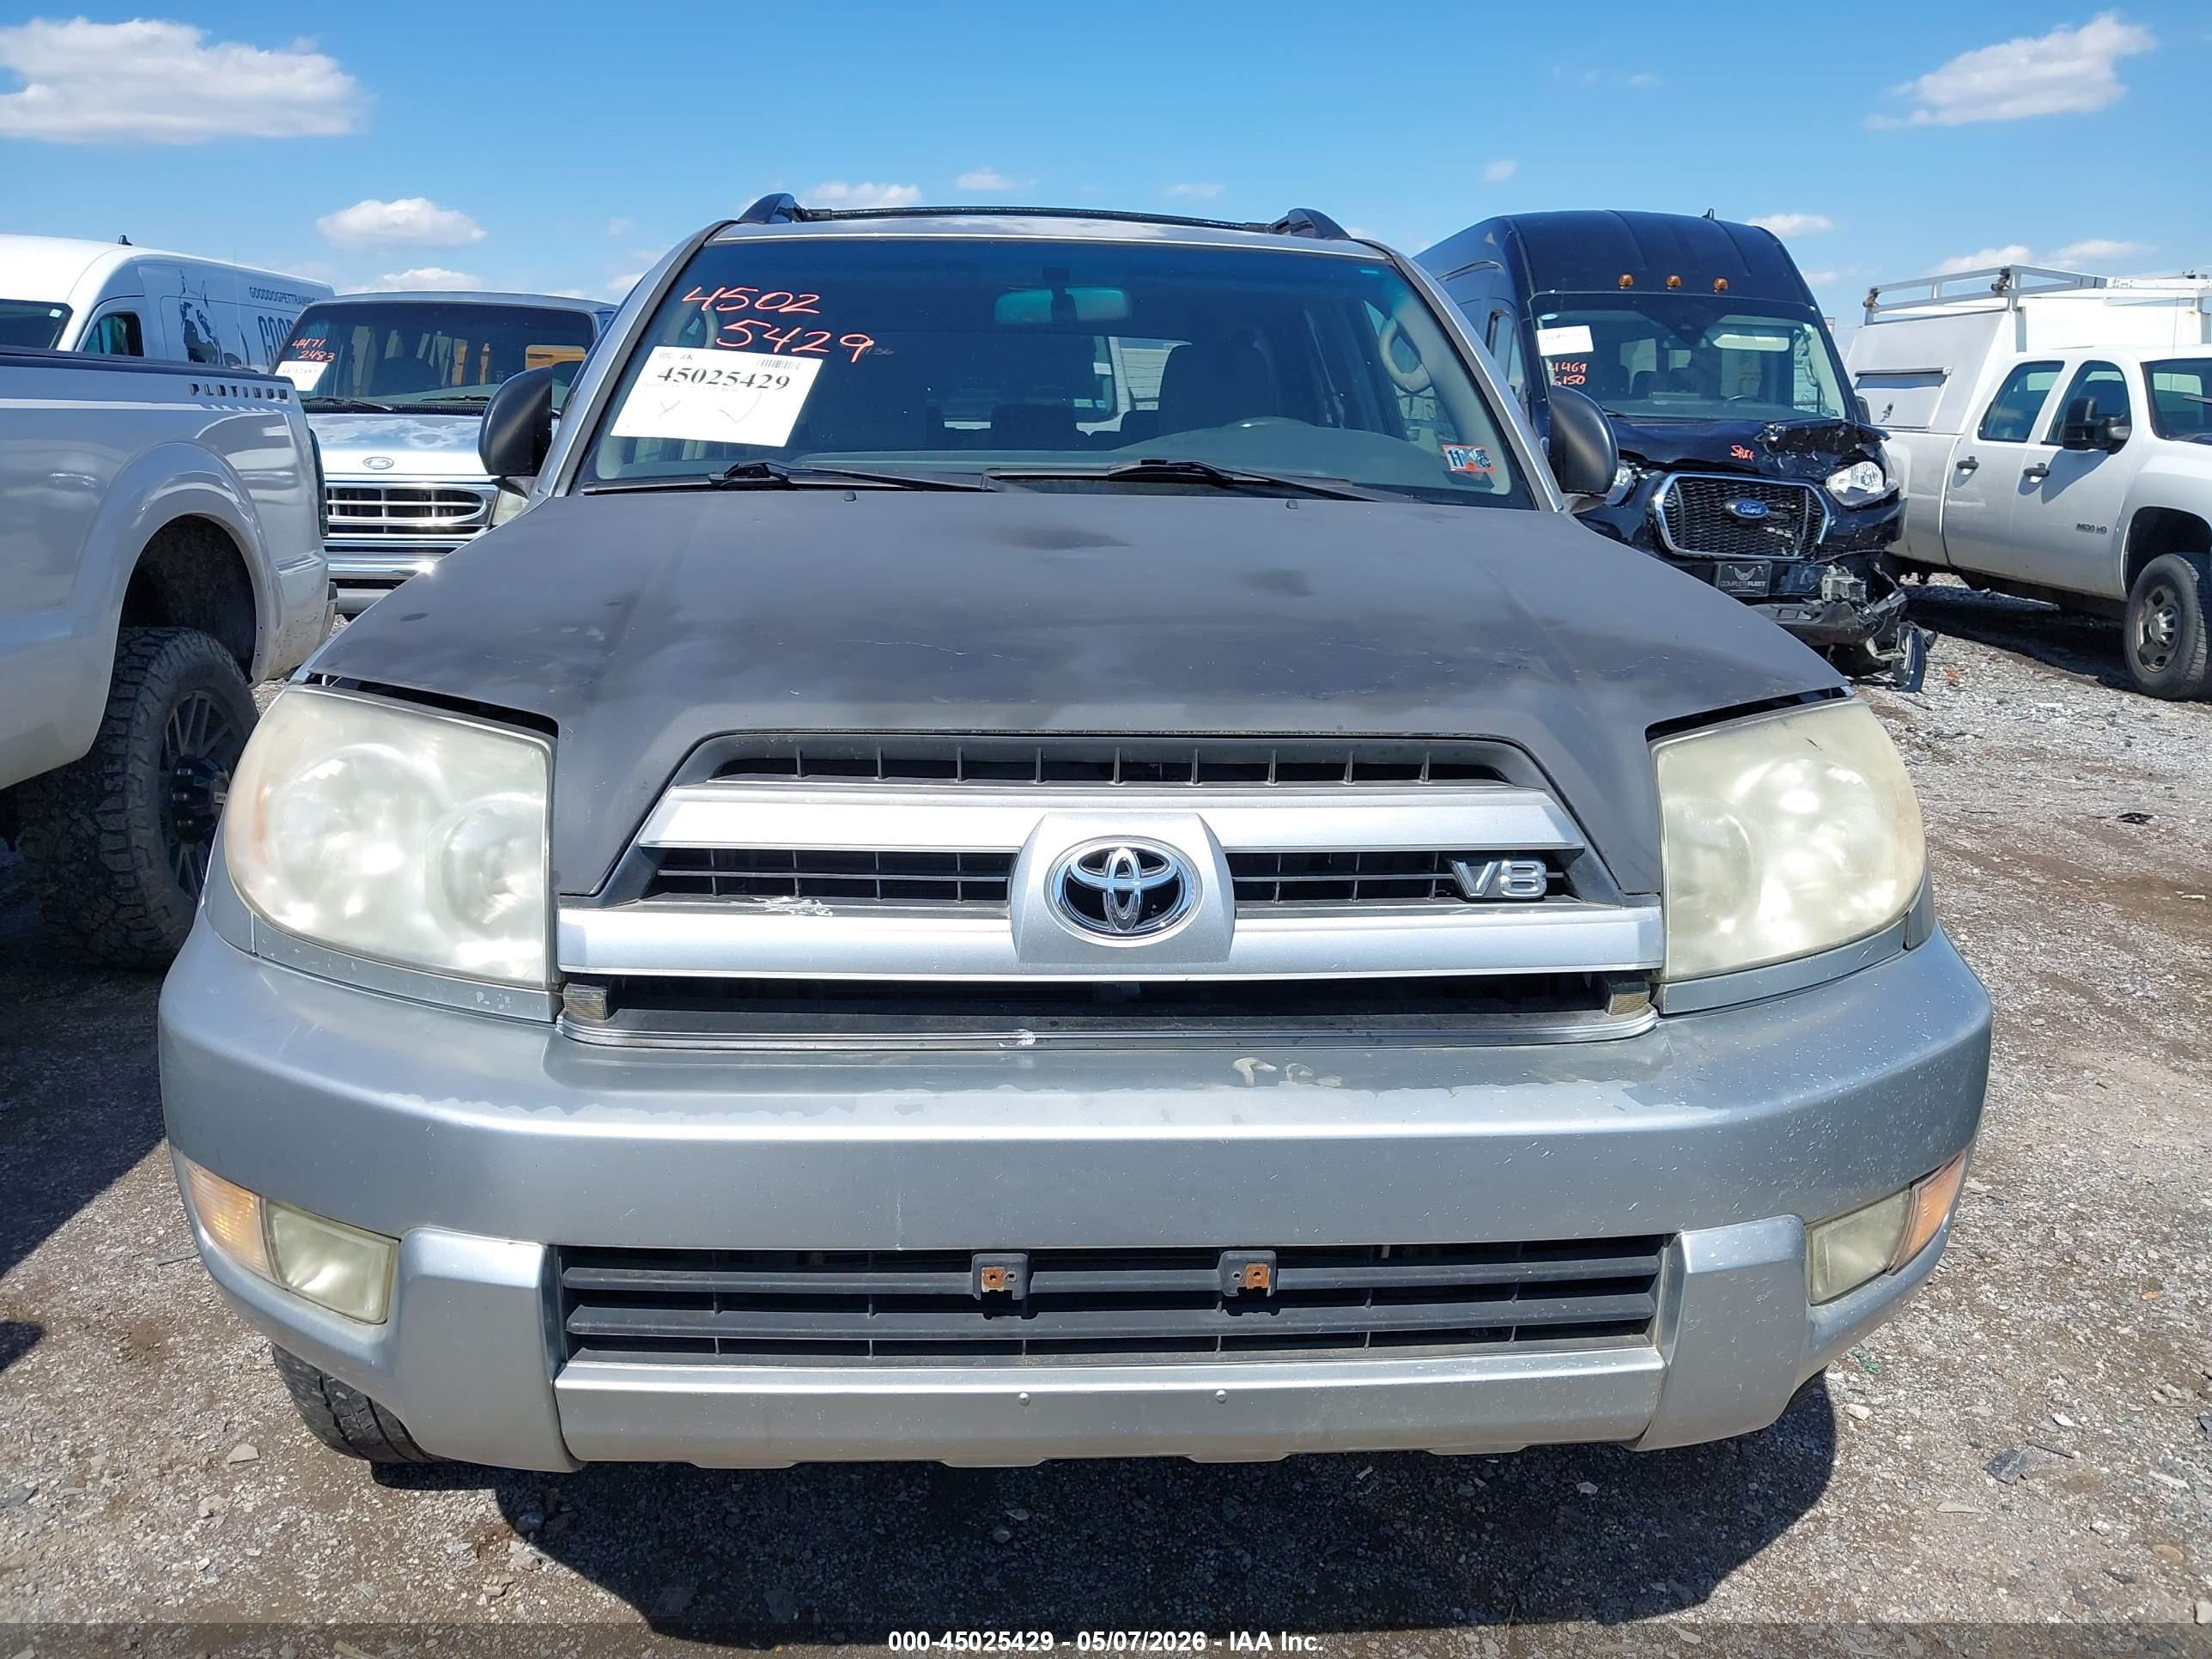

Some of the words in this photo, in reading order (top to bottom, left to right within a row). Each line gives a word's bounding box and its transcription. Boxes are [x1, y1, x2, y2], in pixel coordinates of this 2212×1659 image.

[682, 286, 821, 313] 4502
[292, 337, 326, 349] 4471
[715, 319, 875, 363] 5429
[298, 349, 336, 362] 2483
[657, 367, 791, 391] 45025429
[190, 383, 288, 400] PLATINUM
[1741, 503, 1762, 514] Ford
[1450, 860, 1547, 899] V8
